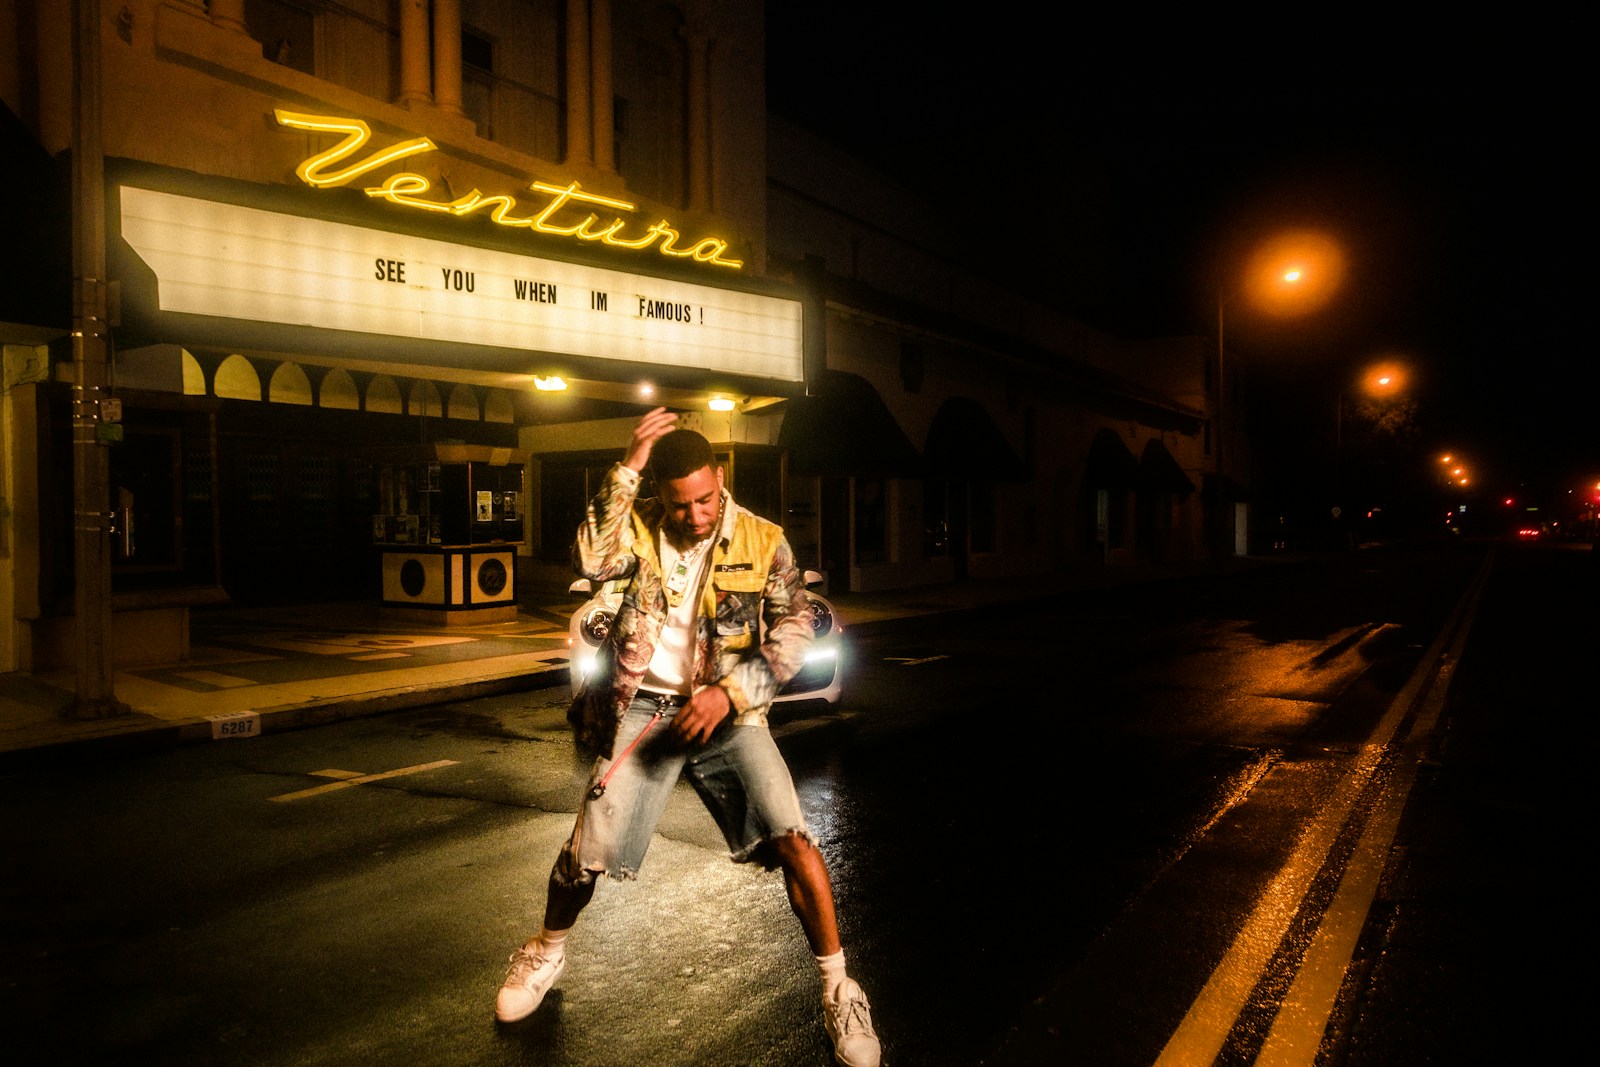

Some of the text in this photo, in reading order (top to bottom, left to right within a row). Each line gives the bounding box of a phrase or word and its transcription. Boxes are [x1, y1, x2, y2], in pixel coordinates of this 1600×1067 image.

[274, 108, 743, 269] Ventura
[375, 258, 406, 284] SEE
[442, 268, 475, 293] YOU
[514, 279, 557, 304] WHEN
[591, 291, 608, 312] IM
[221, 719, 253, 735] 6287
